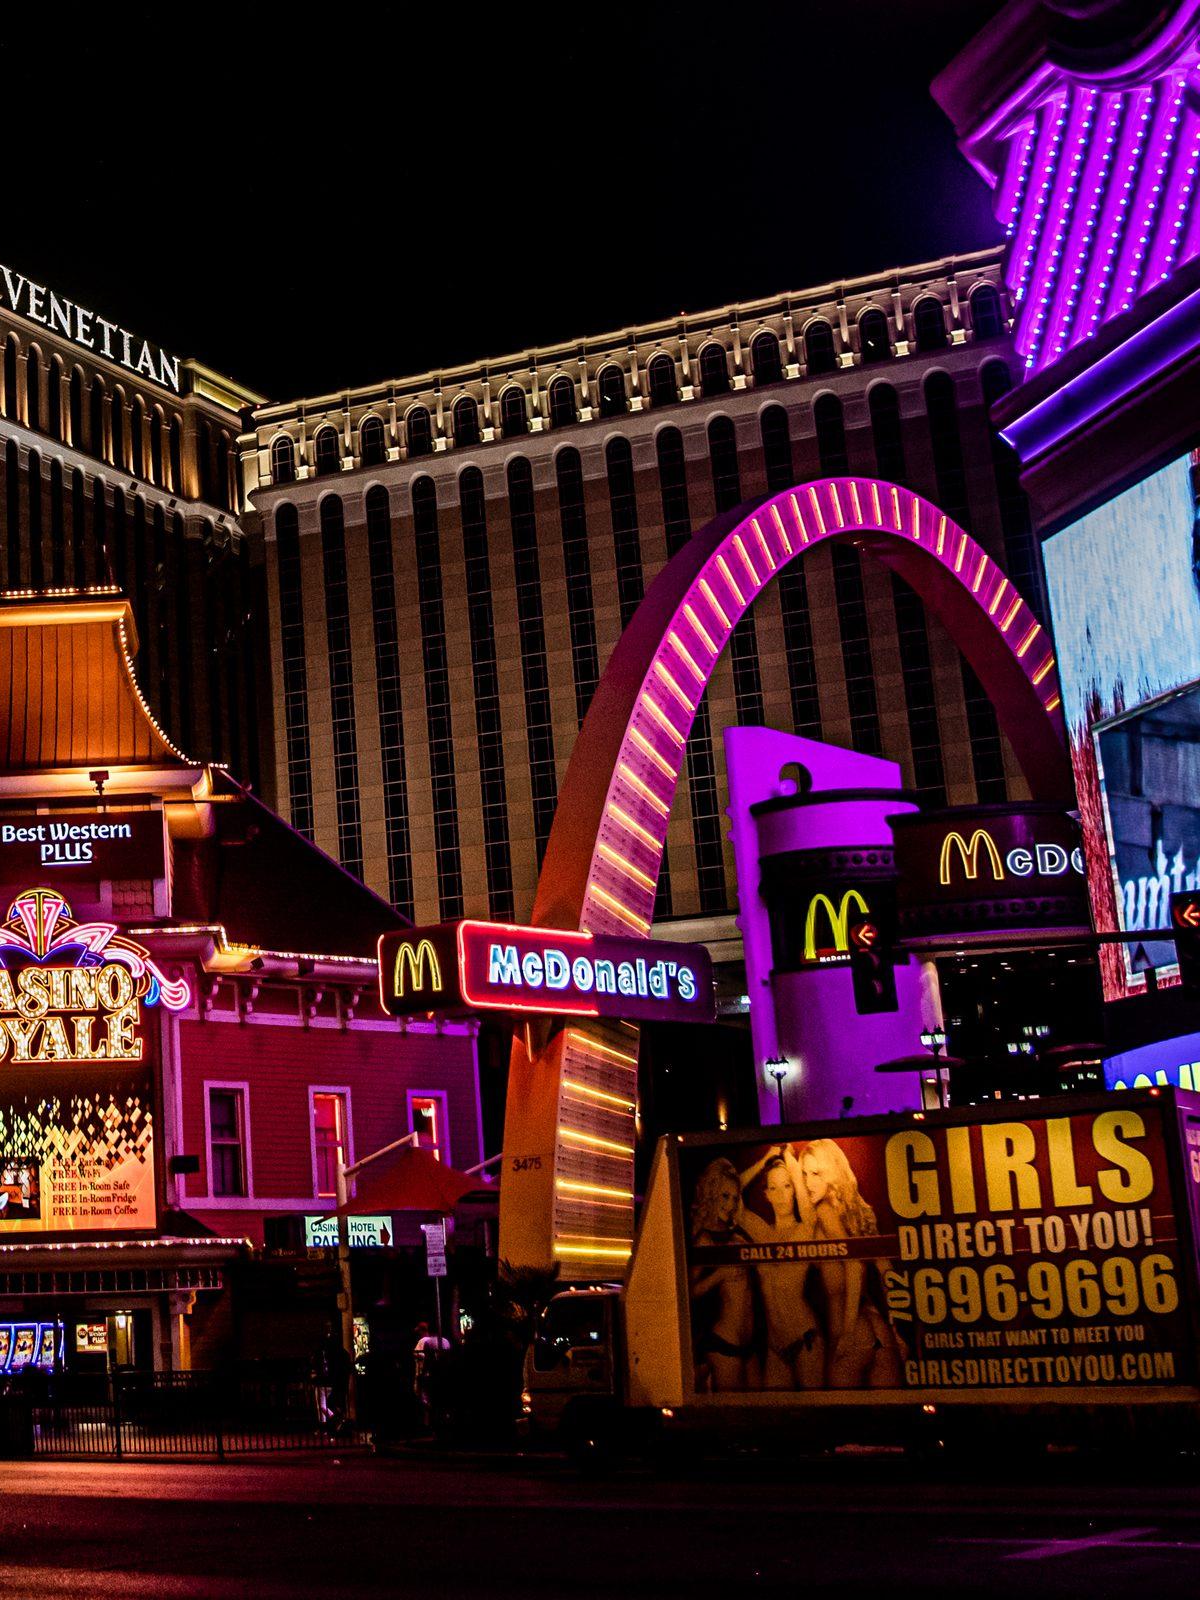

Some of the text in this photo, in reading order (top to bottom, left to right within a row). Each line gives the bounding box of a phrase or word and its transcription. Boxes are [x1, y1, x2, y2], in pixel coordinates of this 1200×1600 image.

[0, 264, 181, 393] VENETIAN
[1, 822, 132, 843] Best Western
[41, 842, 94, 861] PLUS
[488, 944, 697, 1000] McDonald's
[512, 1157, 541, 1172] 3475
[885, 1110, 1154, 1219] GIRLS
[52, 1180, 130, 1191] FREE In-Room Safe
[52, 1194, 77, 1203] FREE
[52, 1205, 138, 1216] FREE In-Room Coffee
[900, 1208, 1154, 1261] DIRECT TO YOU!
[740, 1243, 848, 1261] CALL 24 HOURS
[886, 1269, 913, 1325] 702
[924, 1325, 1144, 1349] GIRLS THAT WANT TO MEET YOU
[905, 1353, 1176, 1385] GIRLSDIRECTTOYOU.COM
